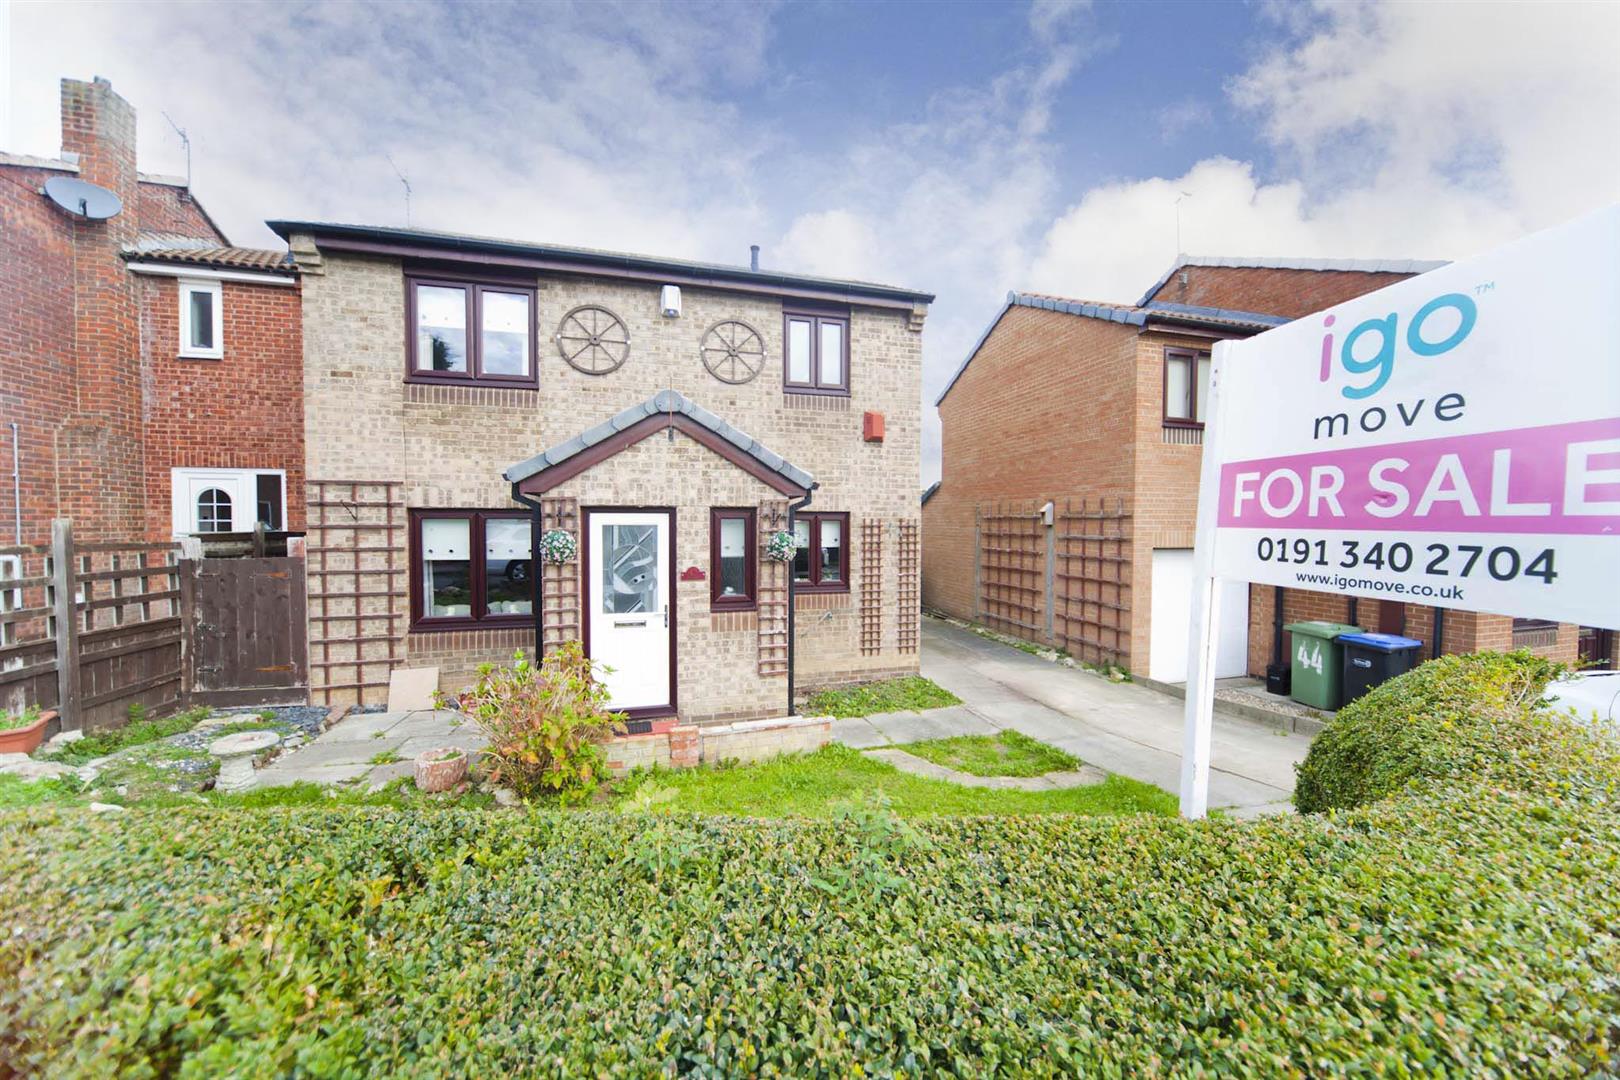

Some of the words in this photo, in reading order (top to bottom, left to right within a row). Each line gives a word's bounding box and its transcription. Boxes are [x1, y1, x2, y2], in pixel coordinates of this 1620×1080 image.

[1319, 292, 1478, 400] igo
[1313, 392, 1466, 439] move
[1233, 464, 1346, 519] FOR
[1363, 438, 1620, 518] SALE
[1257, 536, 1329, 566] 0191
[1340, 540, 1413, 573] 340
[1426, 543, 1559, 584] 2704
[1295, 571, 1464, 600] www.igomove.co.uk
[1297, 641, 1323, 675] 44
